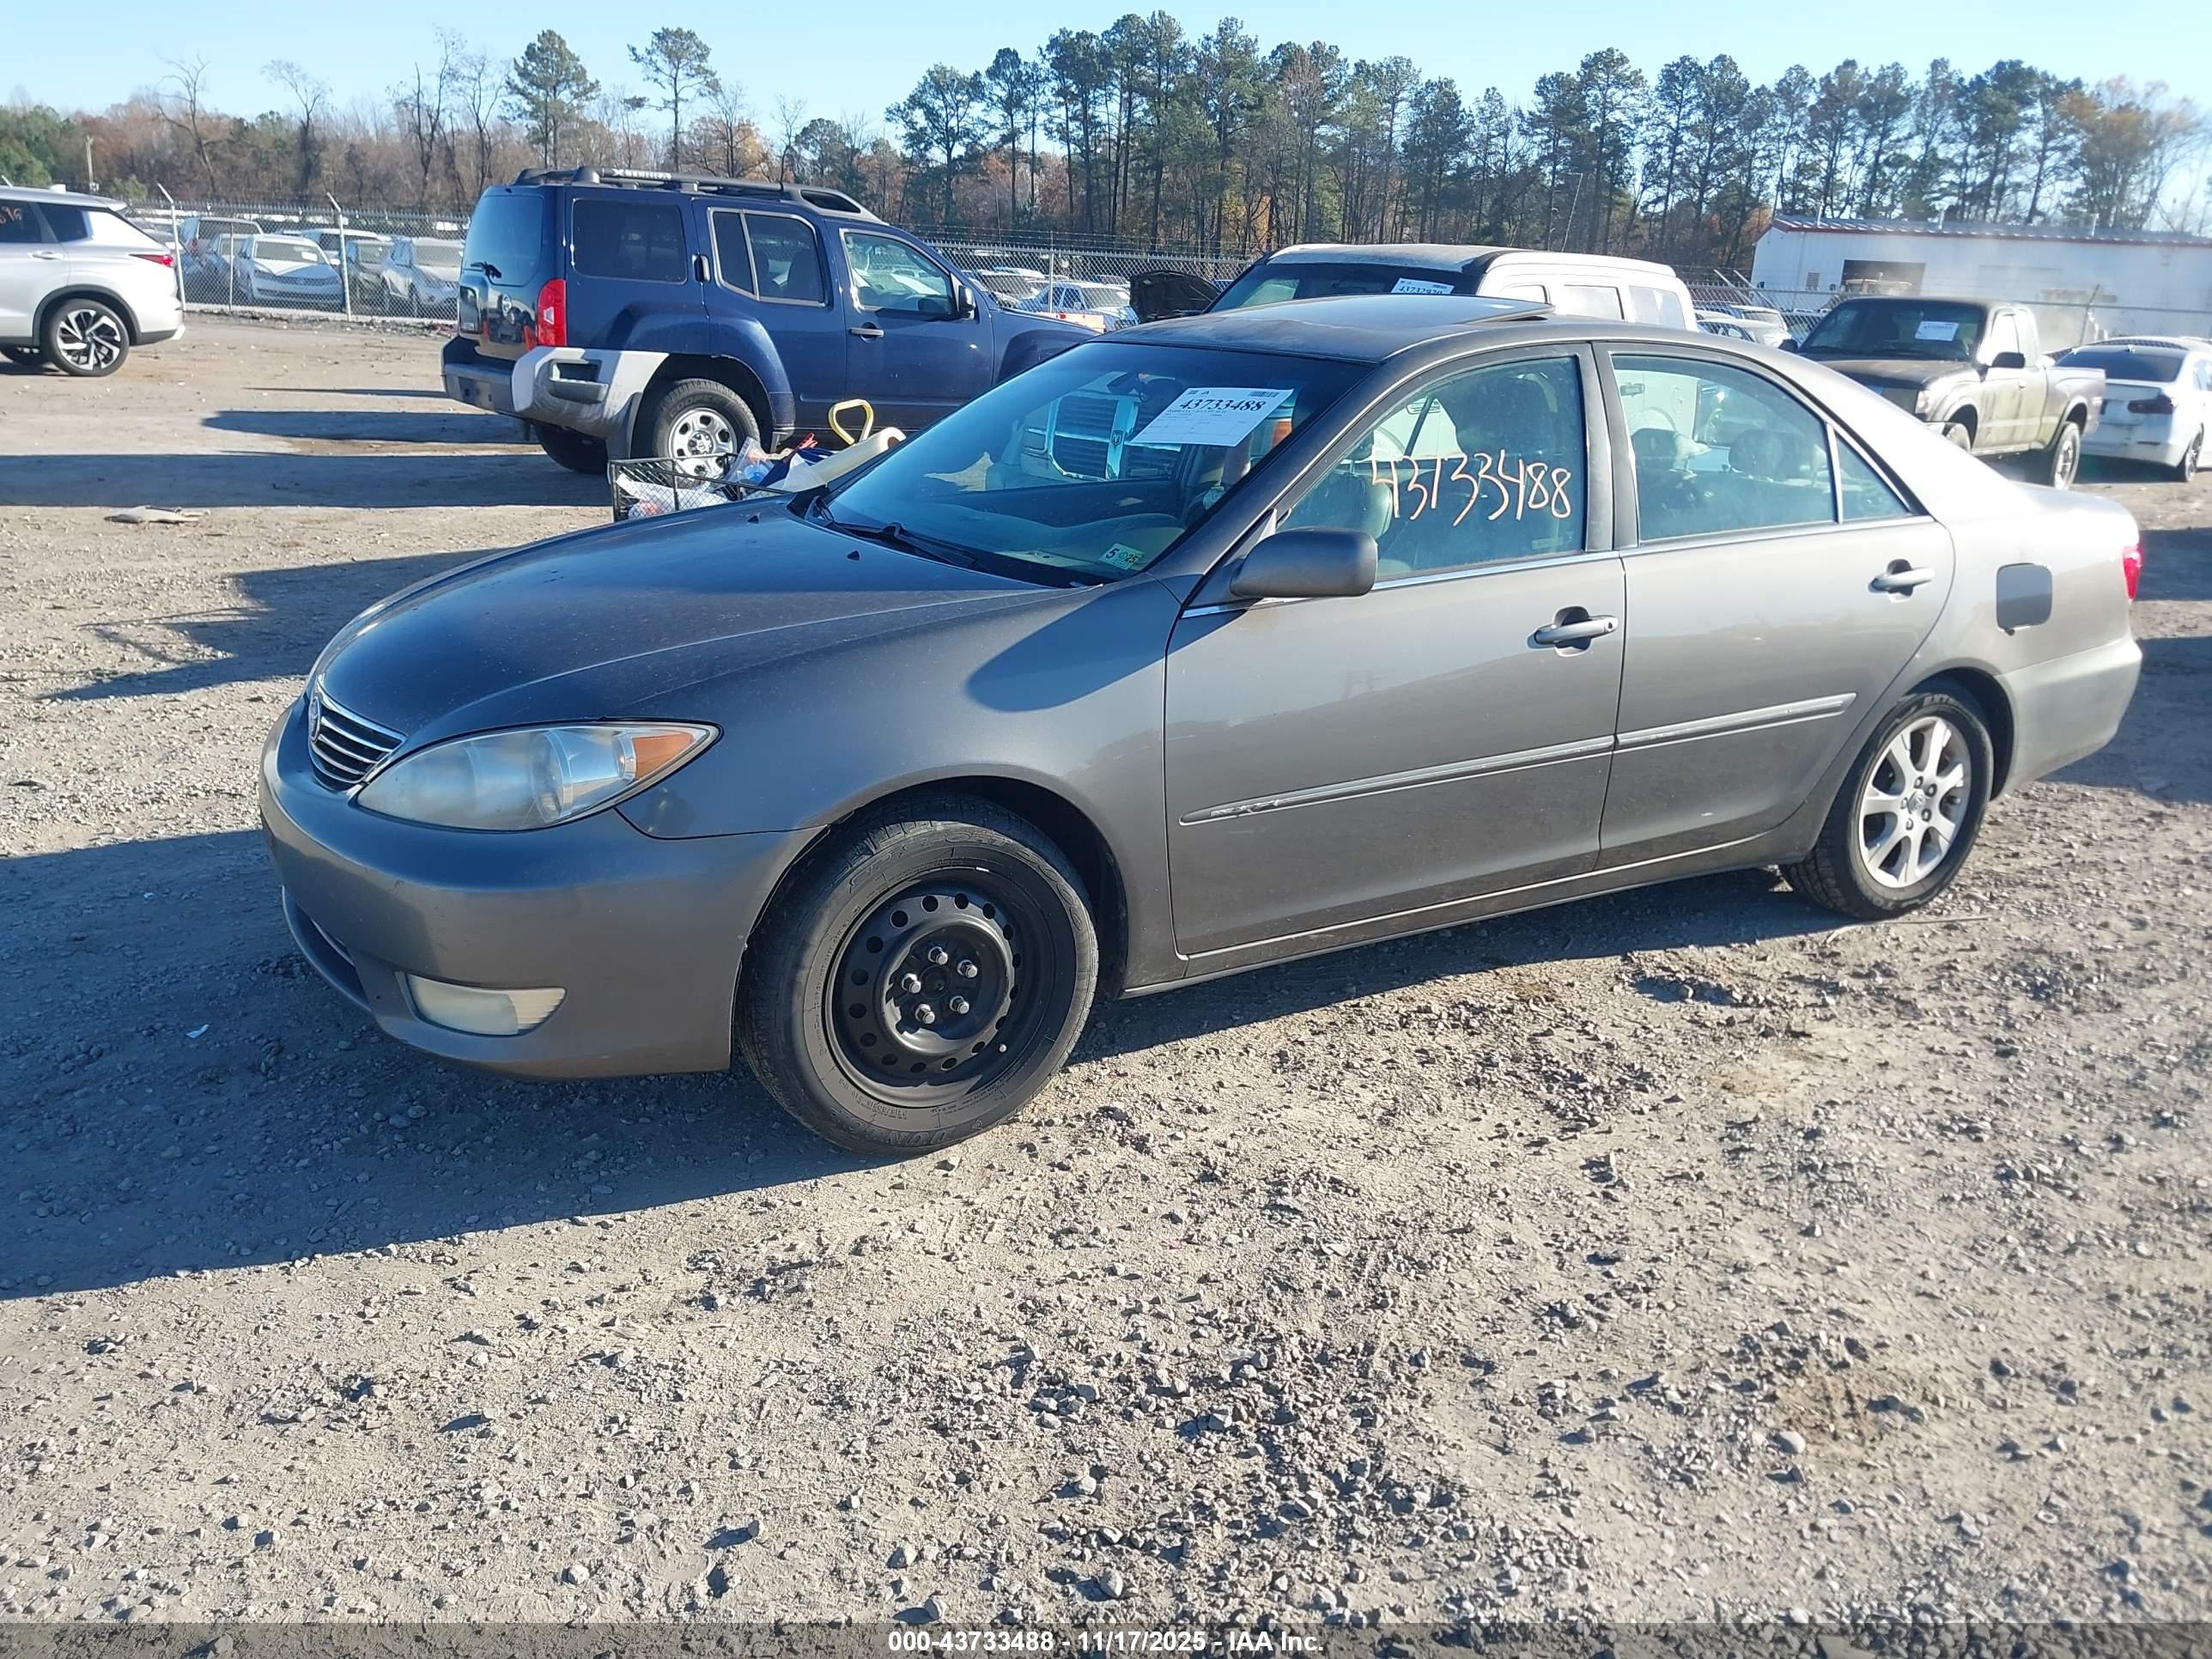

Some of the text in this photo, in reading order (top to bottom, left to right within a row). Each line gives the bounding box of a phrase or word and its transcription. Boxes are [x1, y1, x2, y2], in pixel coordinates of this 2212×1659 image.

[1180, 398, 1267, 411] 43733488
[1370, 446, 1571, 526] 43733488
[1105, 548, 1120, 559] 5
